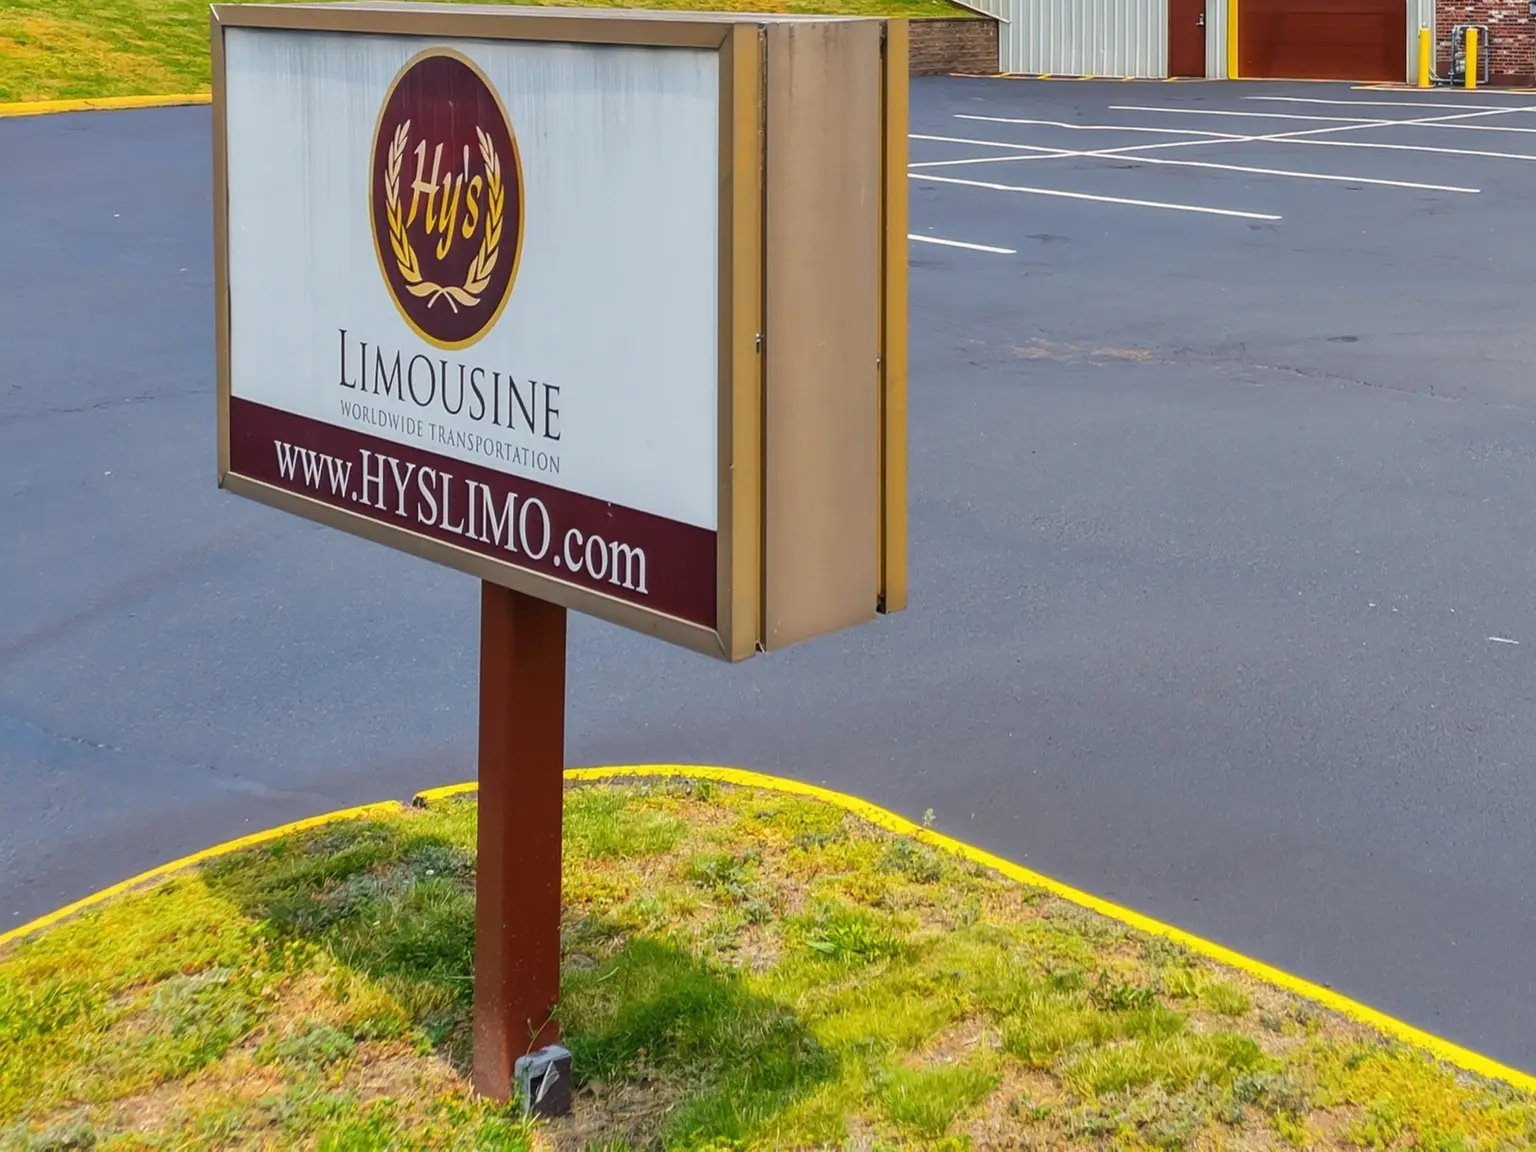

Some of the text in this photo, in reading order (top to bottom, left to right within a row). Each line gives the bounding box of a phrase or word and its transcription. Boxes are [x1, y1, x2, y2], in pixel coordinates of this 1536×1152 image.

[406, 139, 483, 260] Hy's
[338, 328, 562, 441] LIMOUSINE
[340, 399, 561, 474] WORLDWIDE TRANSPORTATION
[274, 440, 649, 594] www.HYSLIMO.com
